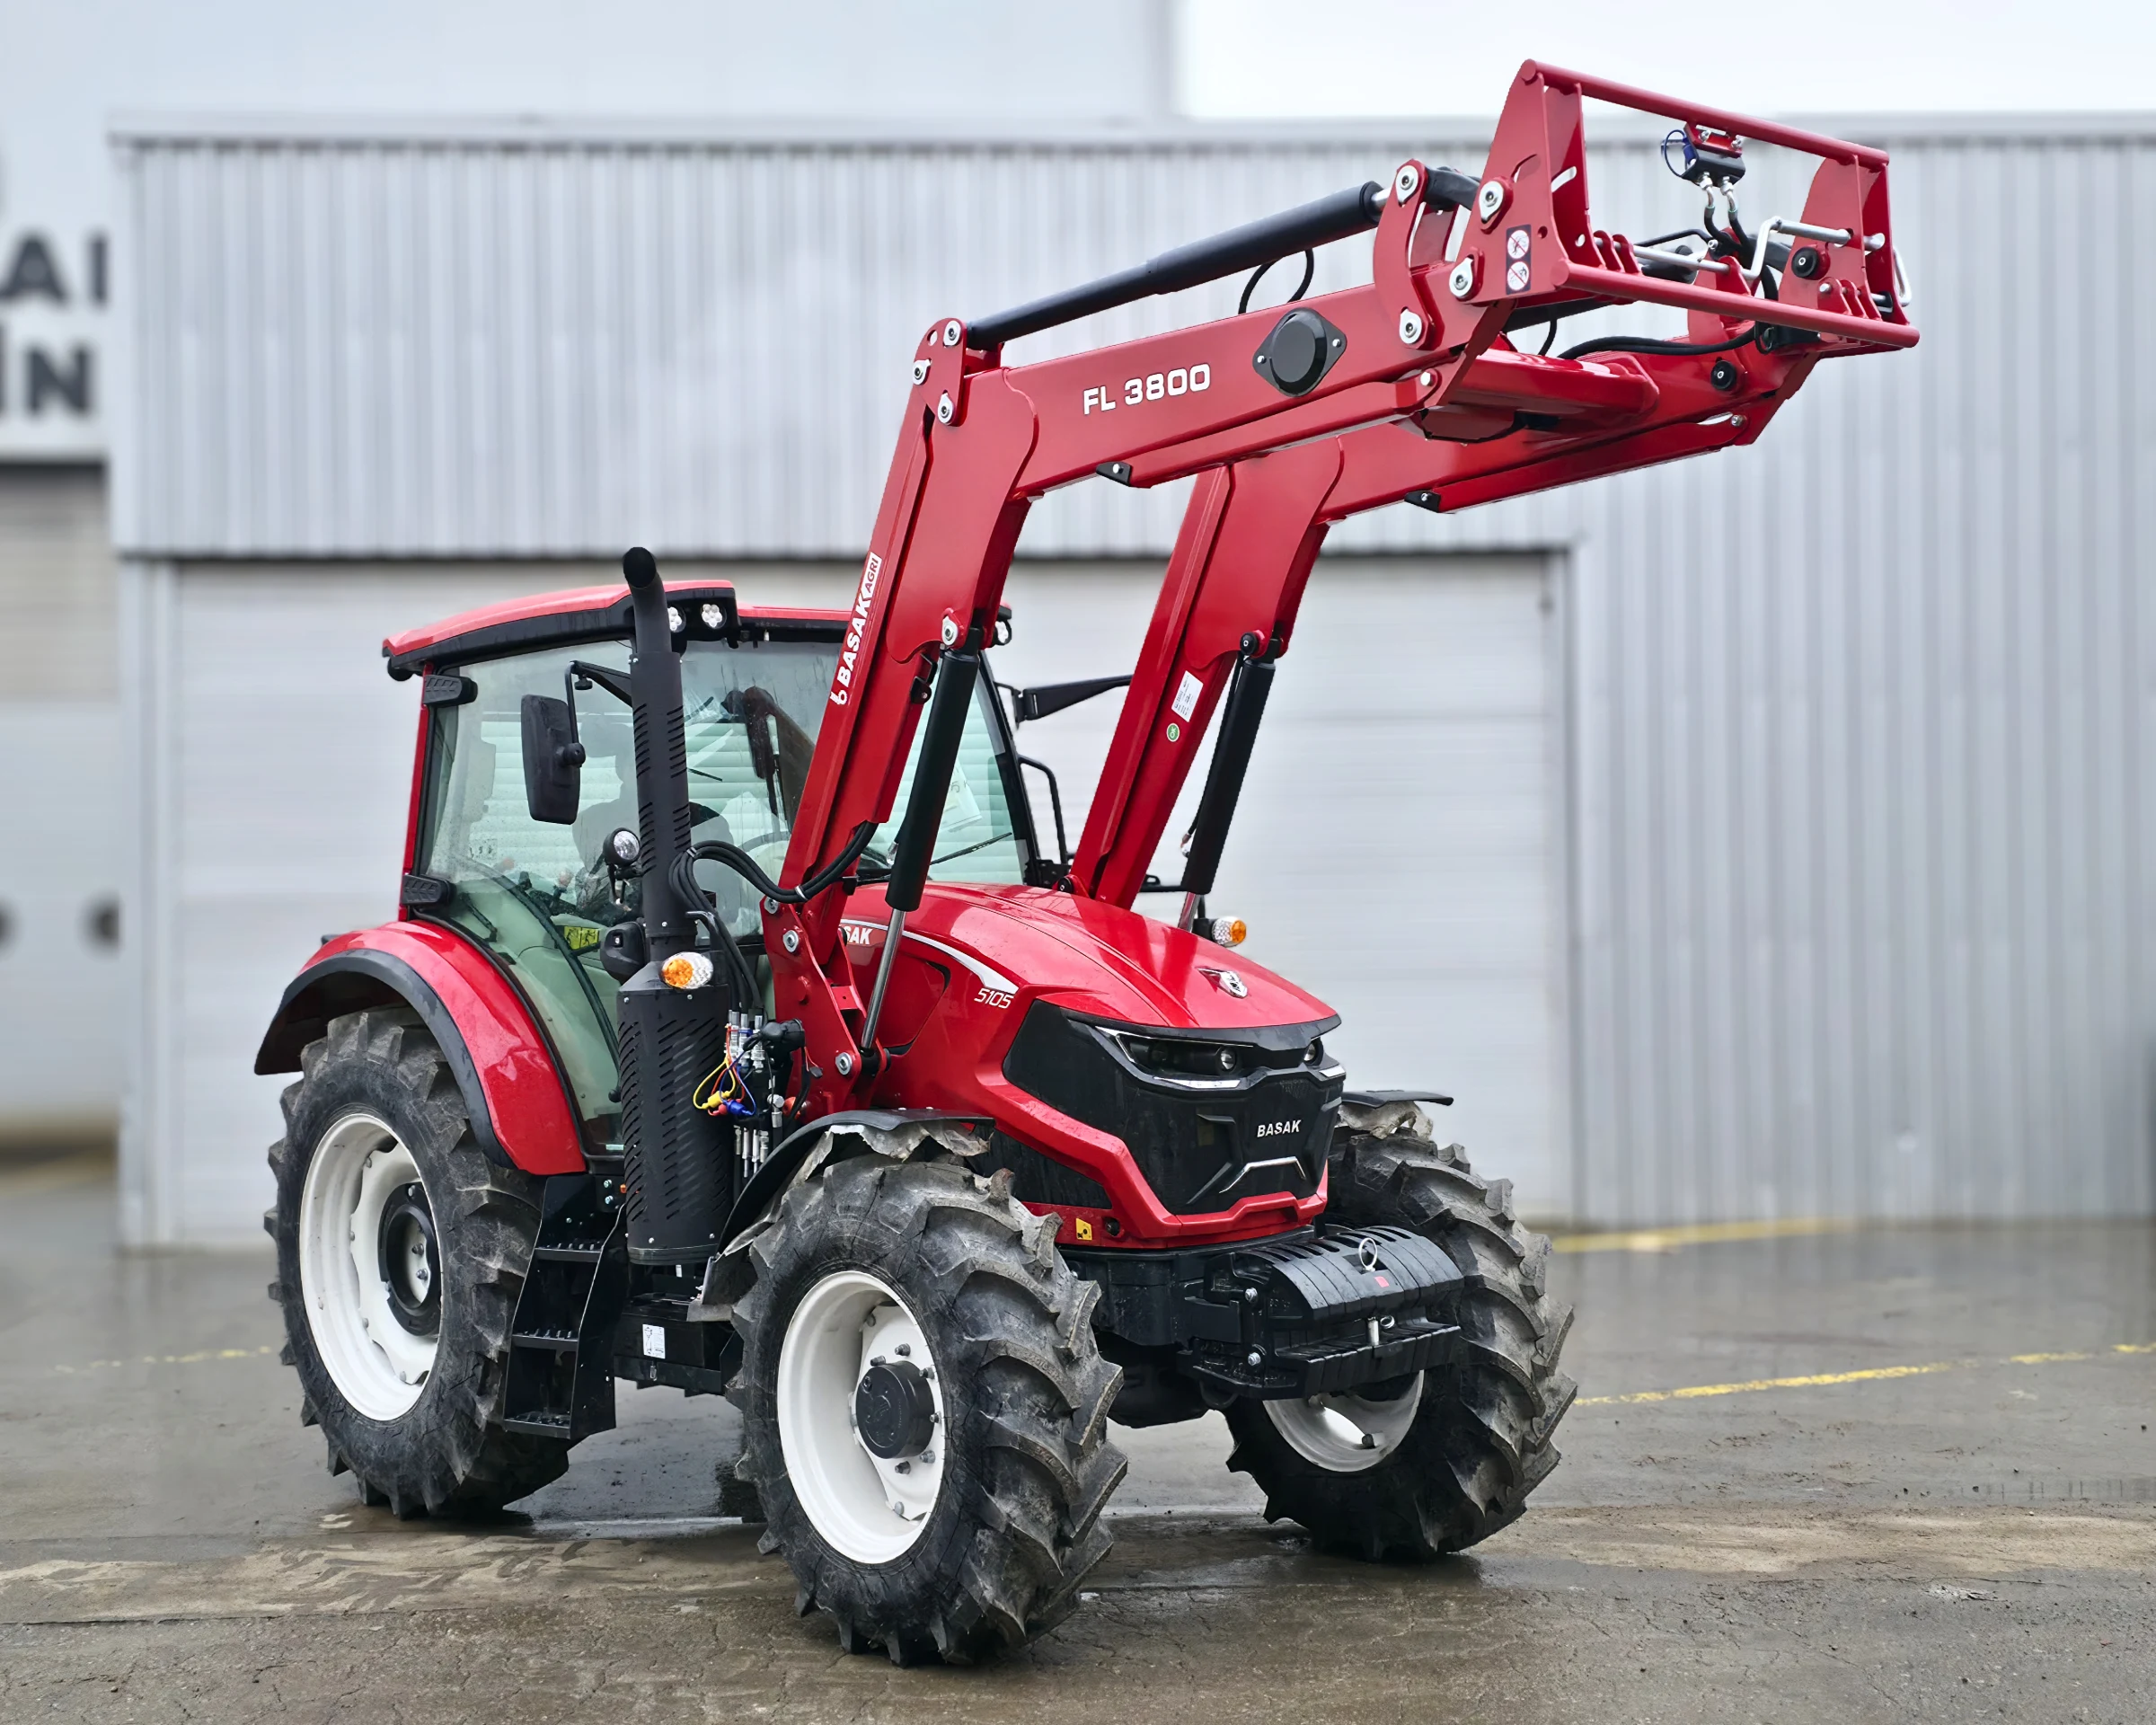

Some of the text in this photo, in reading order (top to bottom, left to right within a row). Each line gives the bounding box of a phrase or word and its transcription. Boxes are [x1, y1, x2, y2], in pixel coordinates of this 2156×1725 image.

[1083, 363, 1211, 415] FL 3800
[836, 557, 879, 688] BASAK AGRI
[1169, 725, 1177, 739] OK
[974, 987, 1014, 1009] 5105
[1257, 1119, 1302, 1138] BASAK
